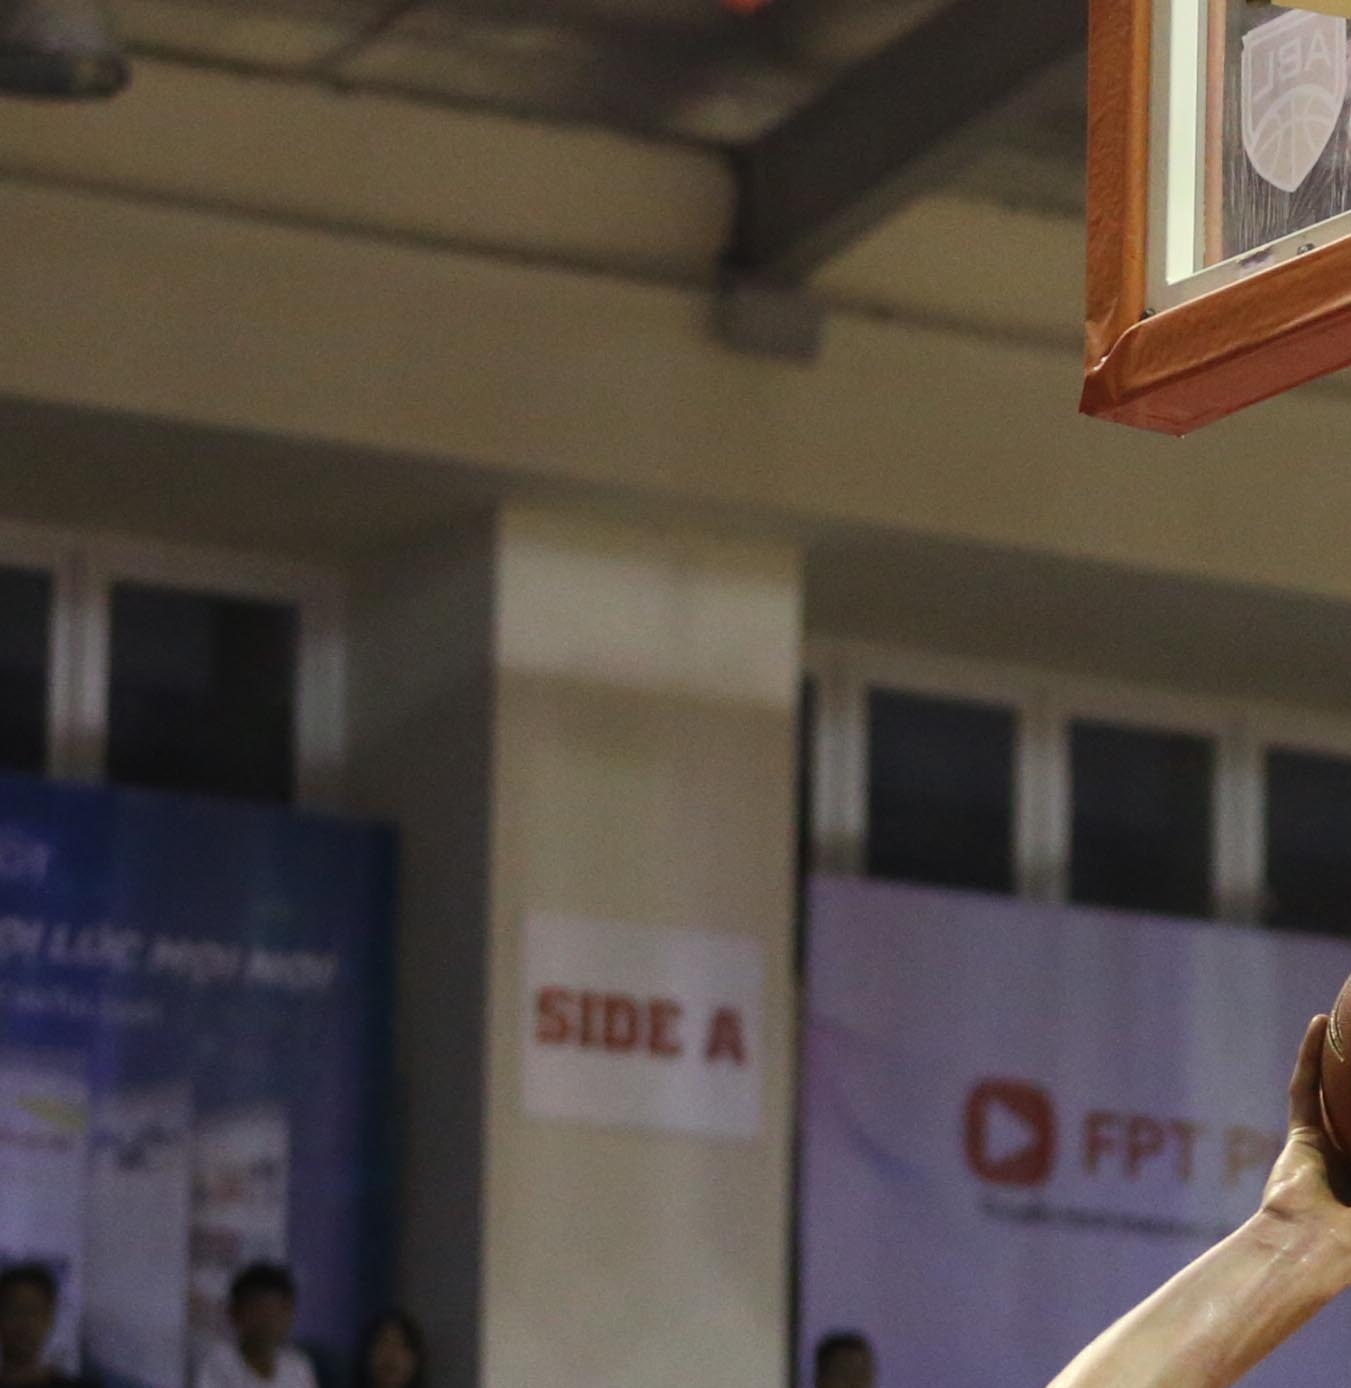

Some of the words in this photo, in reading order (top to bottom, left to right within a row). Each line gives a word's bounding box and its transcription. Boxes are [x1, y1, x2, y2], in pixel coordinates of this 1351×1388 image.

[536, 984, 683, 1058] SIDE
[704, 1006, 747, 1066] A
[1083, 1109, 1204, 1180] FPT
